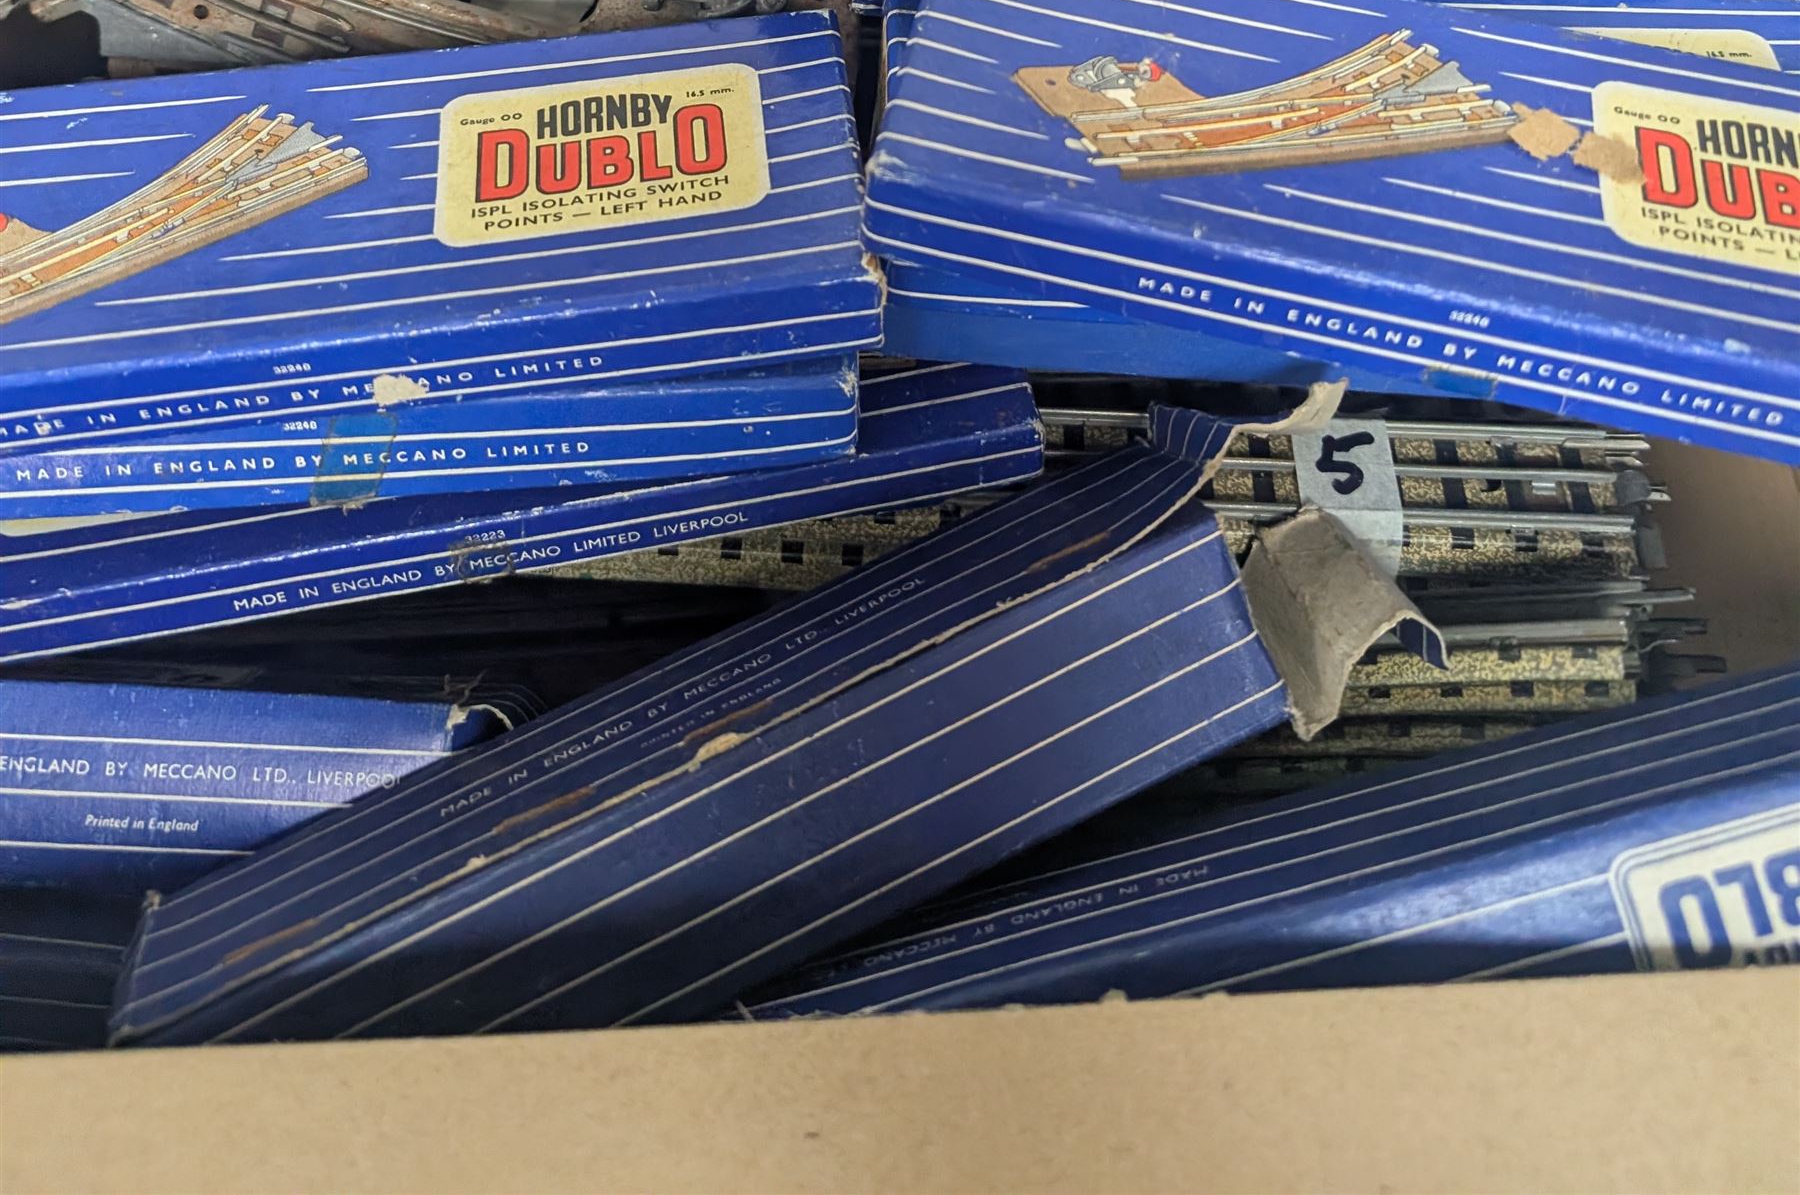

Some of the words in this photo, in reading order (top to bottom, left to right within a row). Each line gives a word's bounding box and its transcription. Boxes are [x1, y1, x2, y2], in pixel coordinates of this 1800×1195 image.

[685, 89, 705, 99] 16.5
[459, 117, 496, 127] Gauge
[536, 92, 673, 140] HORNBY
[1613, 106, 1652, 121] Gauge
[474, 103, 728, 203] DUBLO
[1696, 119, 1800, 170] HORN
[471, 205, 513, 219] ISPL
[522, 188, 637, 212] ISOLATING
[646, 175, 730, 197] SWITCH
[1634, 126, 1800, 231] DUB
[484, 212, 564, 232] POINTS
[600, 200, 649, 216] LEFT
[658, 190, 723, 209] HAND
[1641, 206, 1687, 225] ISPL
[1658, 226, 1745, 252] POINTS
[1137, 276, 1213, 302] MADE
[1233, 297, 1266, 315] IN
[1286, 309, 1424, 349] ENGLAND
[1442, 342, 1478, 360] BY
[1496, 354, 1641, 396] MECCANO
[1660, 389, 1785, 427] LIMITED
[87, 413, 118, 426] IN
[138, 394, 271, 421] ENGLAND
[290, 388, 321, 402] BY
[342, 371, 475, 397] MEANO
[495, 356, 604, 378] LIMITED
[16, 465, 85, 483] MADE
[105, 463, 132, 477] IN
[153, 457, 276, 475] ENGLAND
[294, 454, 323, 469] BY
[343, 447, 468, 466] MECCANO
[486, 441, 591, 458] LIMITED
[1315, 431, 1375, 495] 5
[233, 591, 288, 612] MADE
[298, 586, 320, 600] IN
[332, 569, 423, 595] ENGLAND
[434, 563, 456, 577] BY
[469, 545, 562, 571] MECCANO
[573, 531, 642, 553] LIMITED
[653, 511, 749, 539] LIVERPOOL
[439, 787, 493, 818] MADE
[507, 769, 529, 786] IN
[543, 720, 634, 769] ENGLAND
[647, 702, 669, 719] BY
[684, 653, 772, 700] MECCANO
[834, 577, 926, 626] LIVERPOOL
[105, 761, 128, 777] BY
[143, 763, 237, 781] MECCANO
[85, 814, 129, 829] Printed
[133, 818, 145, 829] in
[148, 817, 200, 833] England
[1118, 884, 1140, 896] IN
[1156, 865, 1209, 888] MADE
[1010, 892, 1104, 926] ENGLAND
[863, 934, 957, 967] MECCANO
[972, 923, 996, 940] BY
